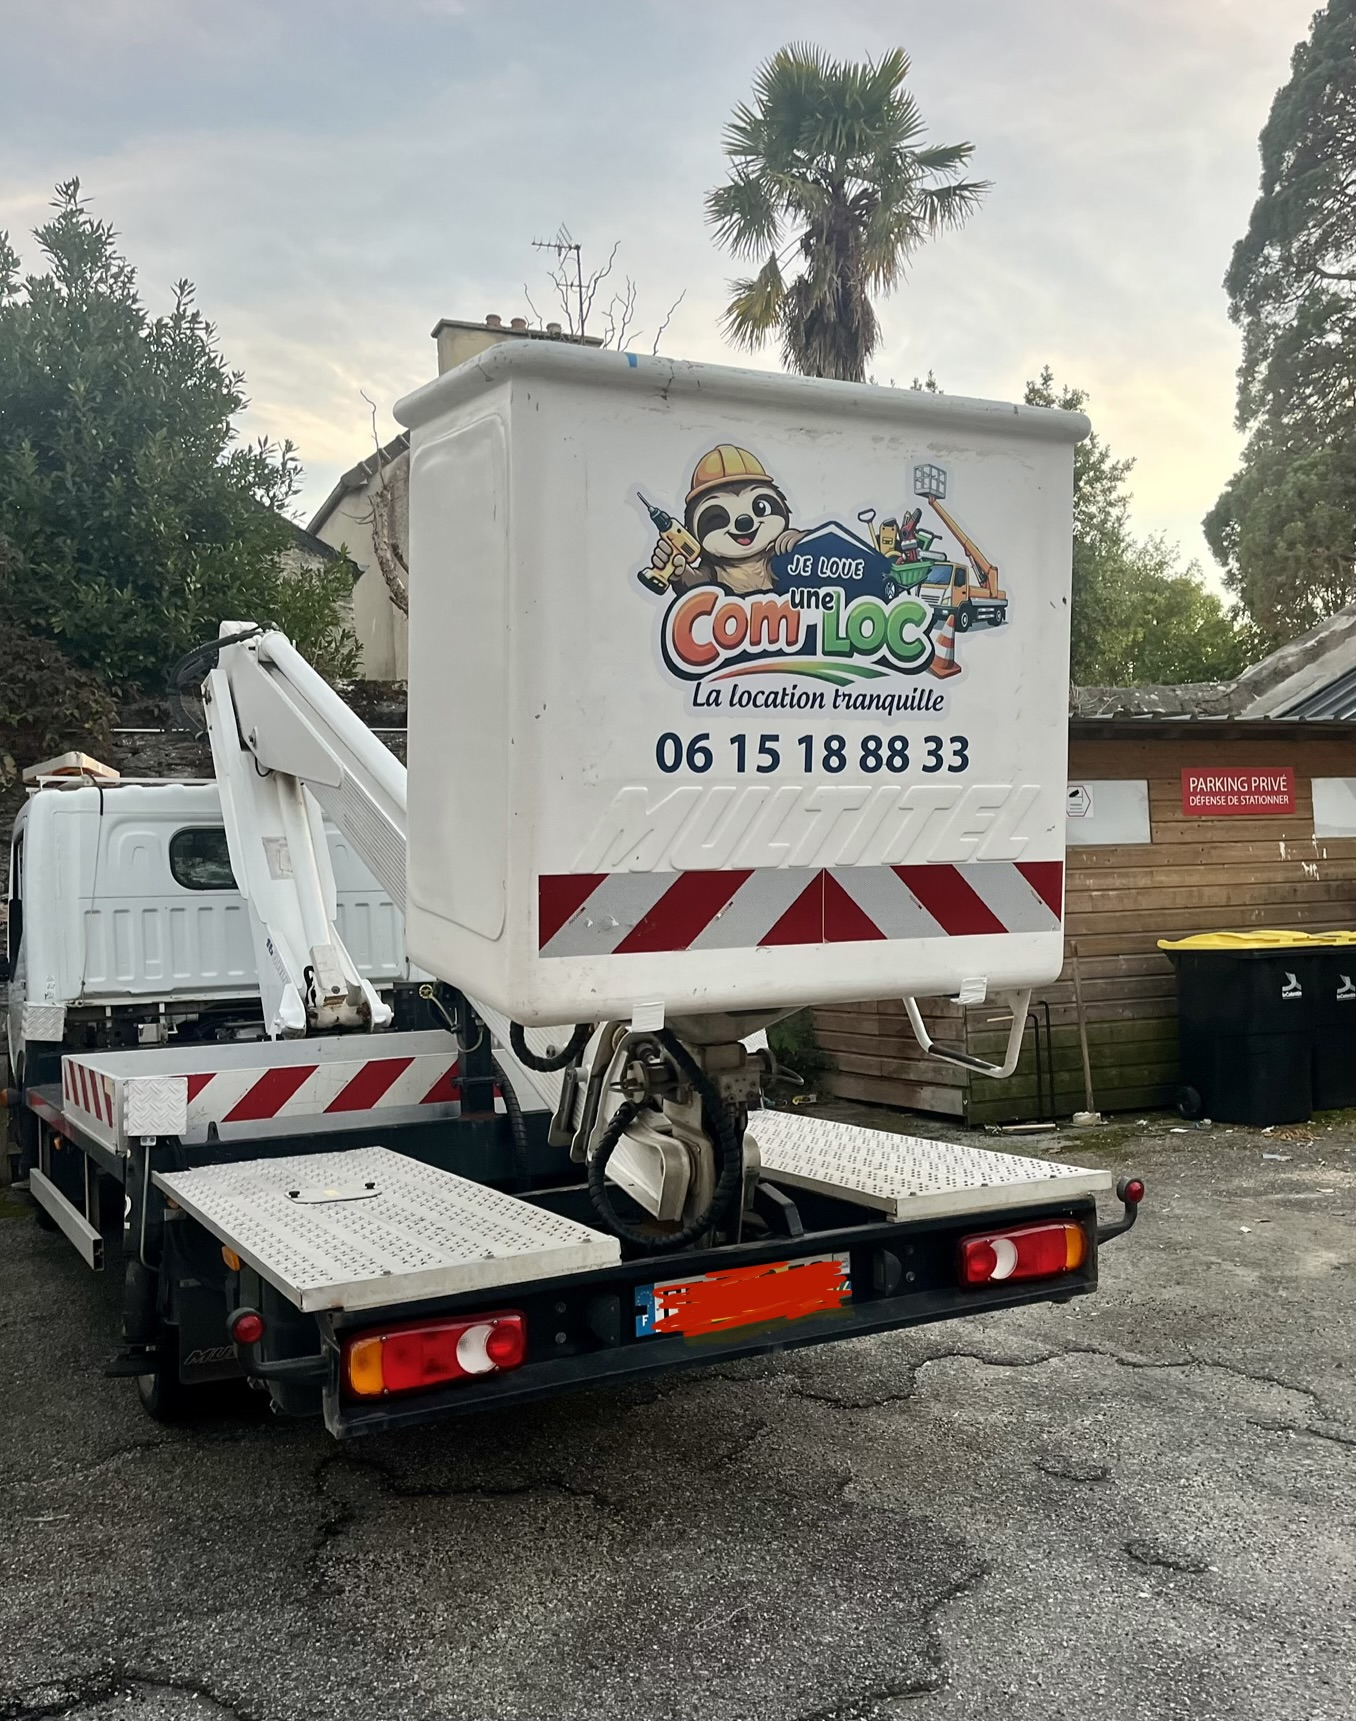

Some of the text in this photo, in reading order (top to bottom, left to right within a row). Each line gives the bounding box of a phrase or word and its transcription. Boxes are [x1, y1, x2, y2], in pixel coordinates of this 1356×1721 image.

[787, 554, 865, 579] JE LOUE
[790, 586, 834, 610] une
[821, 586, 931, 663] LOC
[692, 682, 945, 716] La location tranquille
[655, 732, 970, 774] 06 15 18 88 33
[1189, 774, 1288, 793] PARKING PRIVÉ
[1189, 794, 1290, 807] DÉFENSE DE STATIONNER
[570, 784, 1042, 875] MULTITEL
[641, 1313, 648, 1327] F
